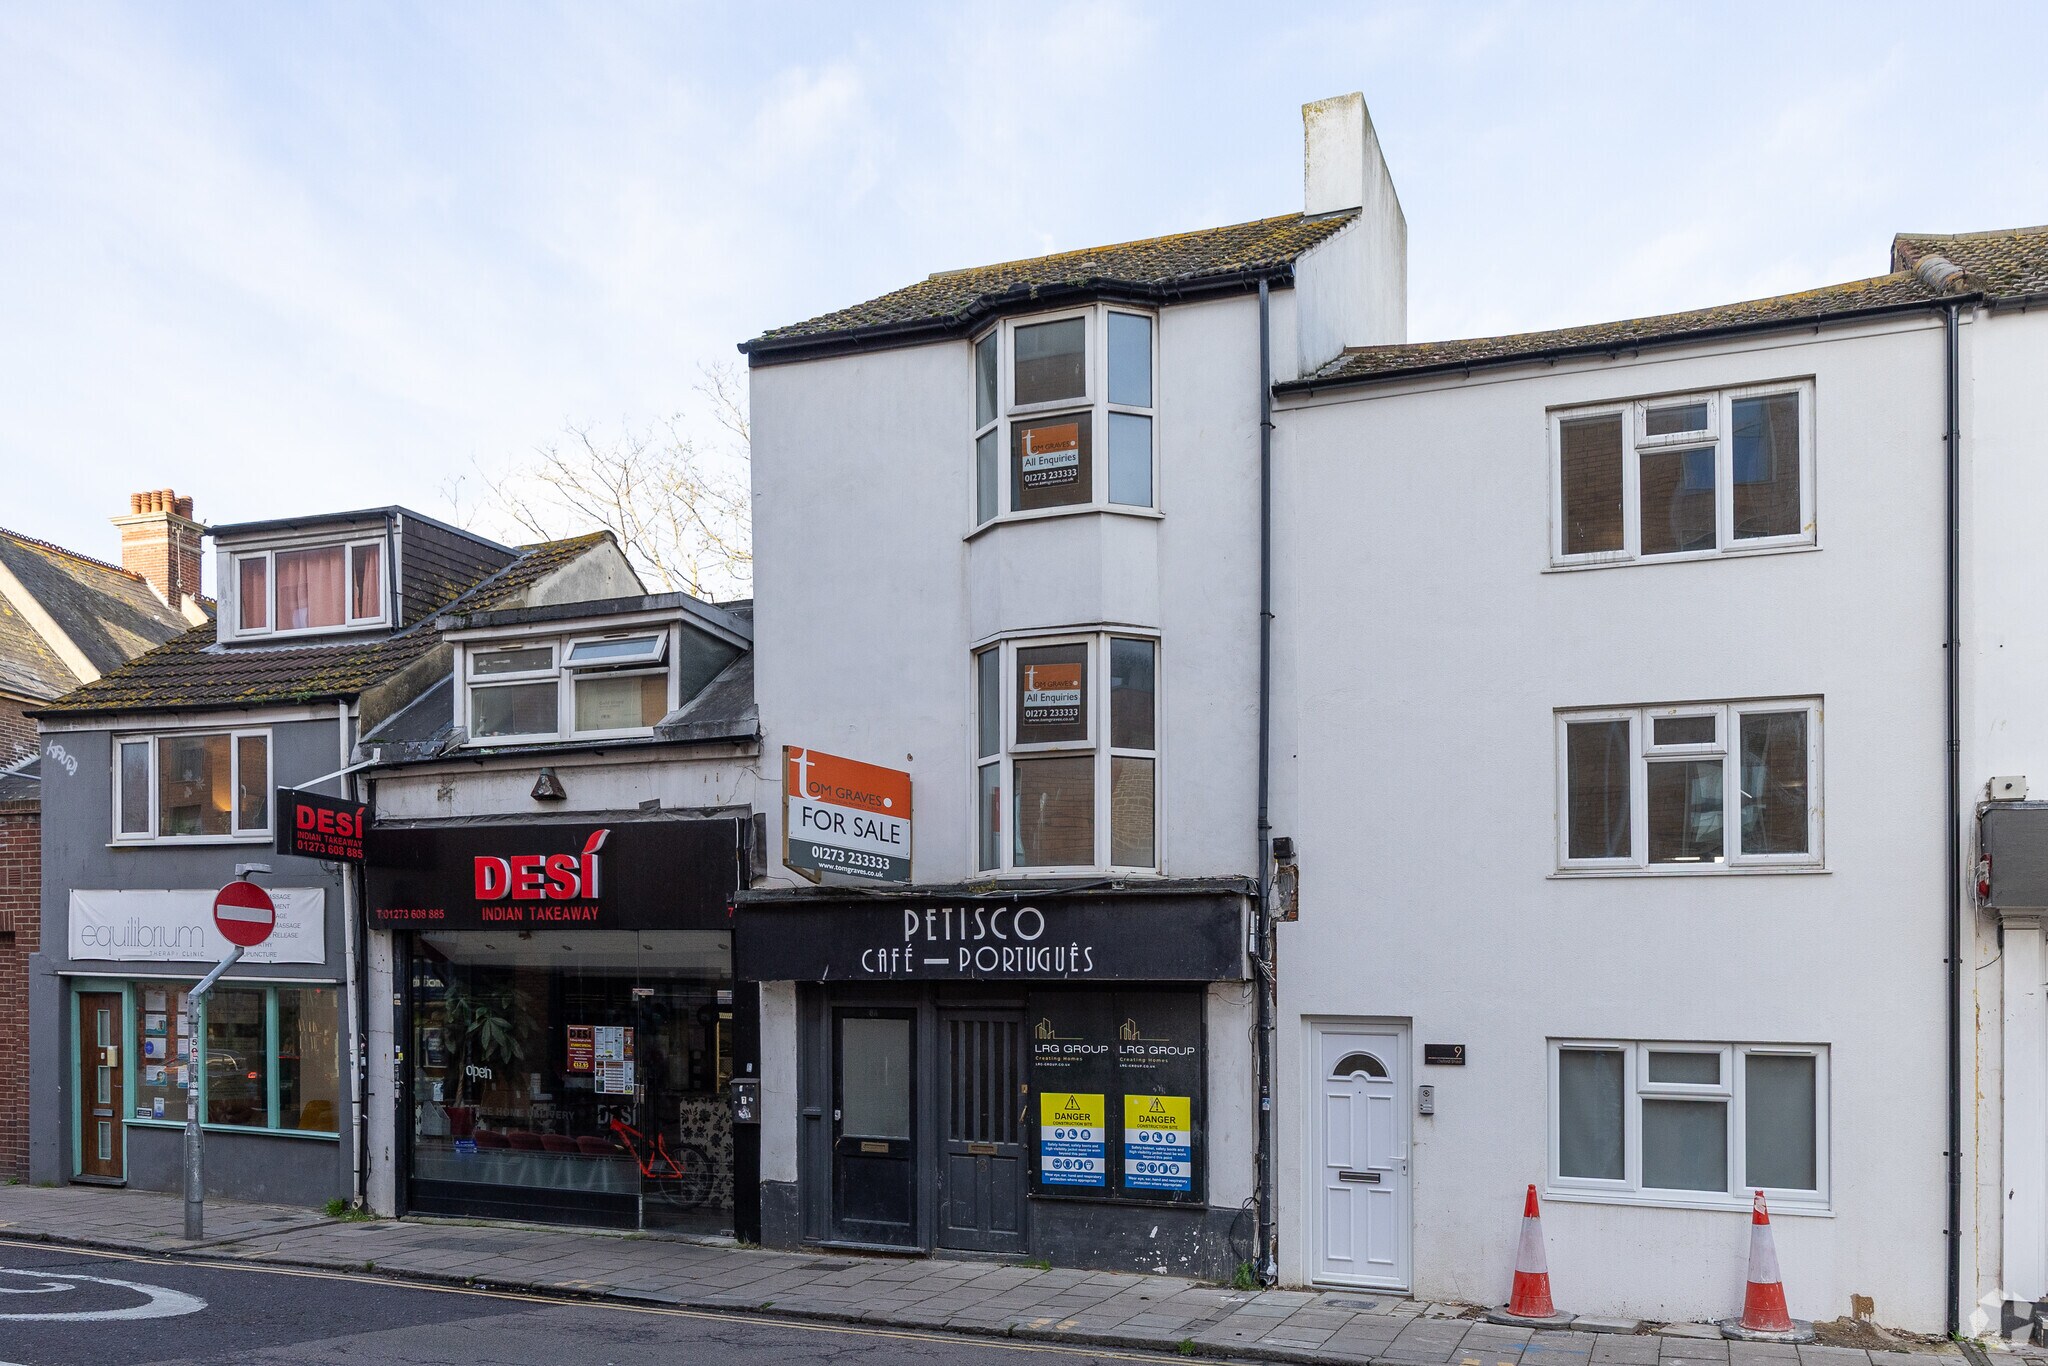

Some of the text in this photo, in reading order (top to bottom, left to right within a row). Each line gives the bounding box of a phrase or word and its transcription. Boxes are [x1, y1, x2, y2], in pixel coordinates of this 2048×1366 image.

[1045, 441, 1070, 449] GRAVES
[1025, 454, 1076, 467] All Enquiries
[1024, 468, 1077, 482] 01273 233333
[1026, 693, 1078, 704] All Enquiries
[1026, 708, 1078, 718] 01273 233333
[835, 788, 882, 807] GRAVES
[296, 804, 366, 838] DESÍ
[802, 806, 900, 844] FOR SALE
[298, 831, 362, 847] INDIAN TAKEAWAY
[297, 840, 363, 859] 01273 608 885
[811, 846, 890, 869] 01273 233333
[474, 829, 610, 900] DESÍ
[818, 862, 883, 878] www.tomgraves.co.uk
[411, 909, 426, 919] 608
[429, 909, 444, 919] 885
[482, 906, 599, 920] INDIAN TAKEAWAY
[904, 907, 1045, 942] PETISCO
[81, 917, 204, 955] equilibrium
[862, 944, 913, 972] CAFÉ
[959, 942, 1094, 972] PORTUGUÊS
[1034, 1044, 1108, 1054] LRG GROUP
[1119, 1046, 1195, 1056] LRG GROUP
[1454, 1046, 1462, 1057] 9
[466, 1064, 491, 1082] open
[1139, 1115, 1175, 1123] DANGER
